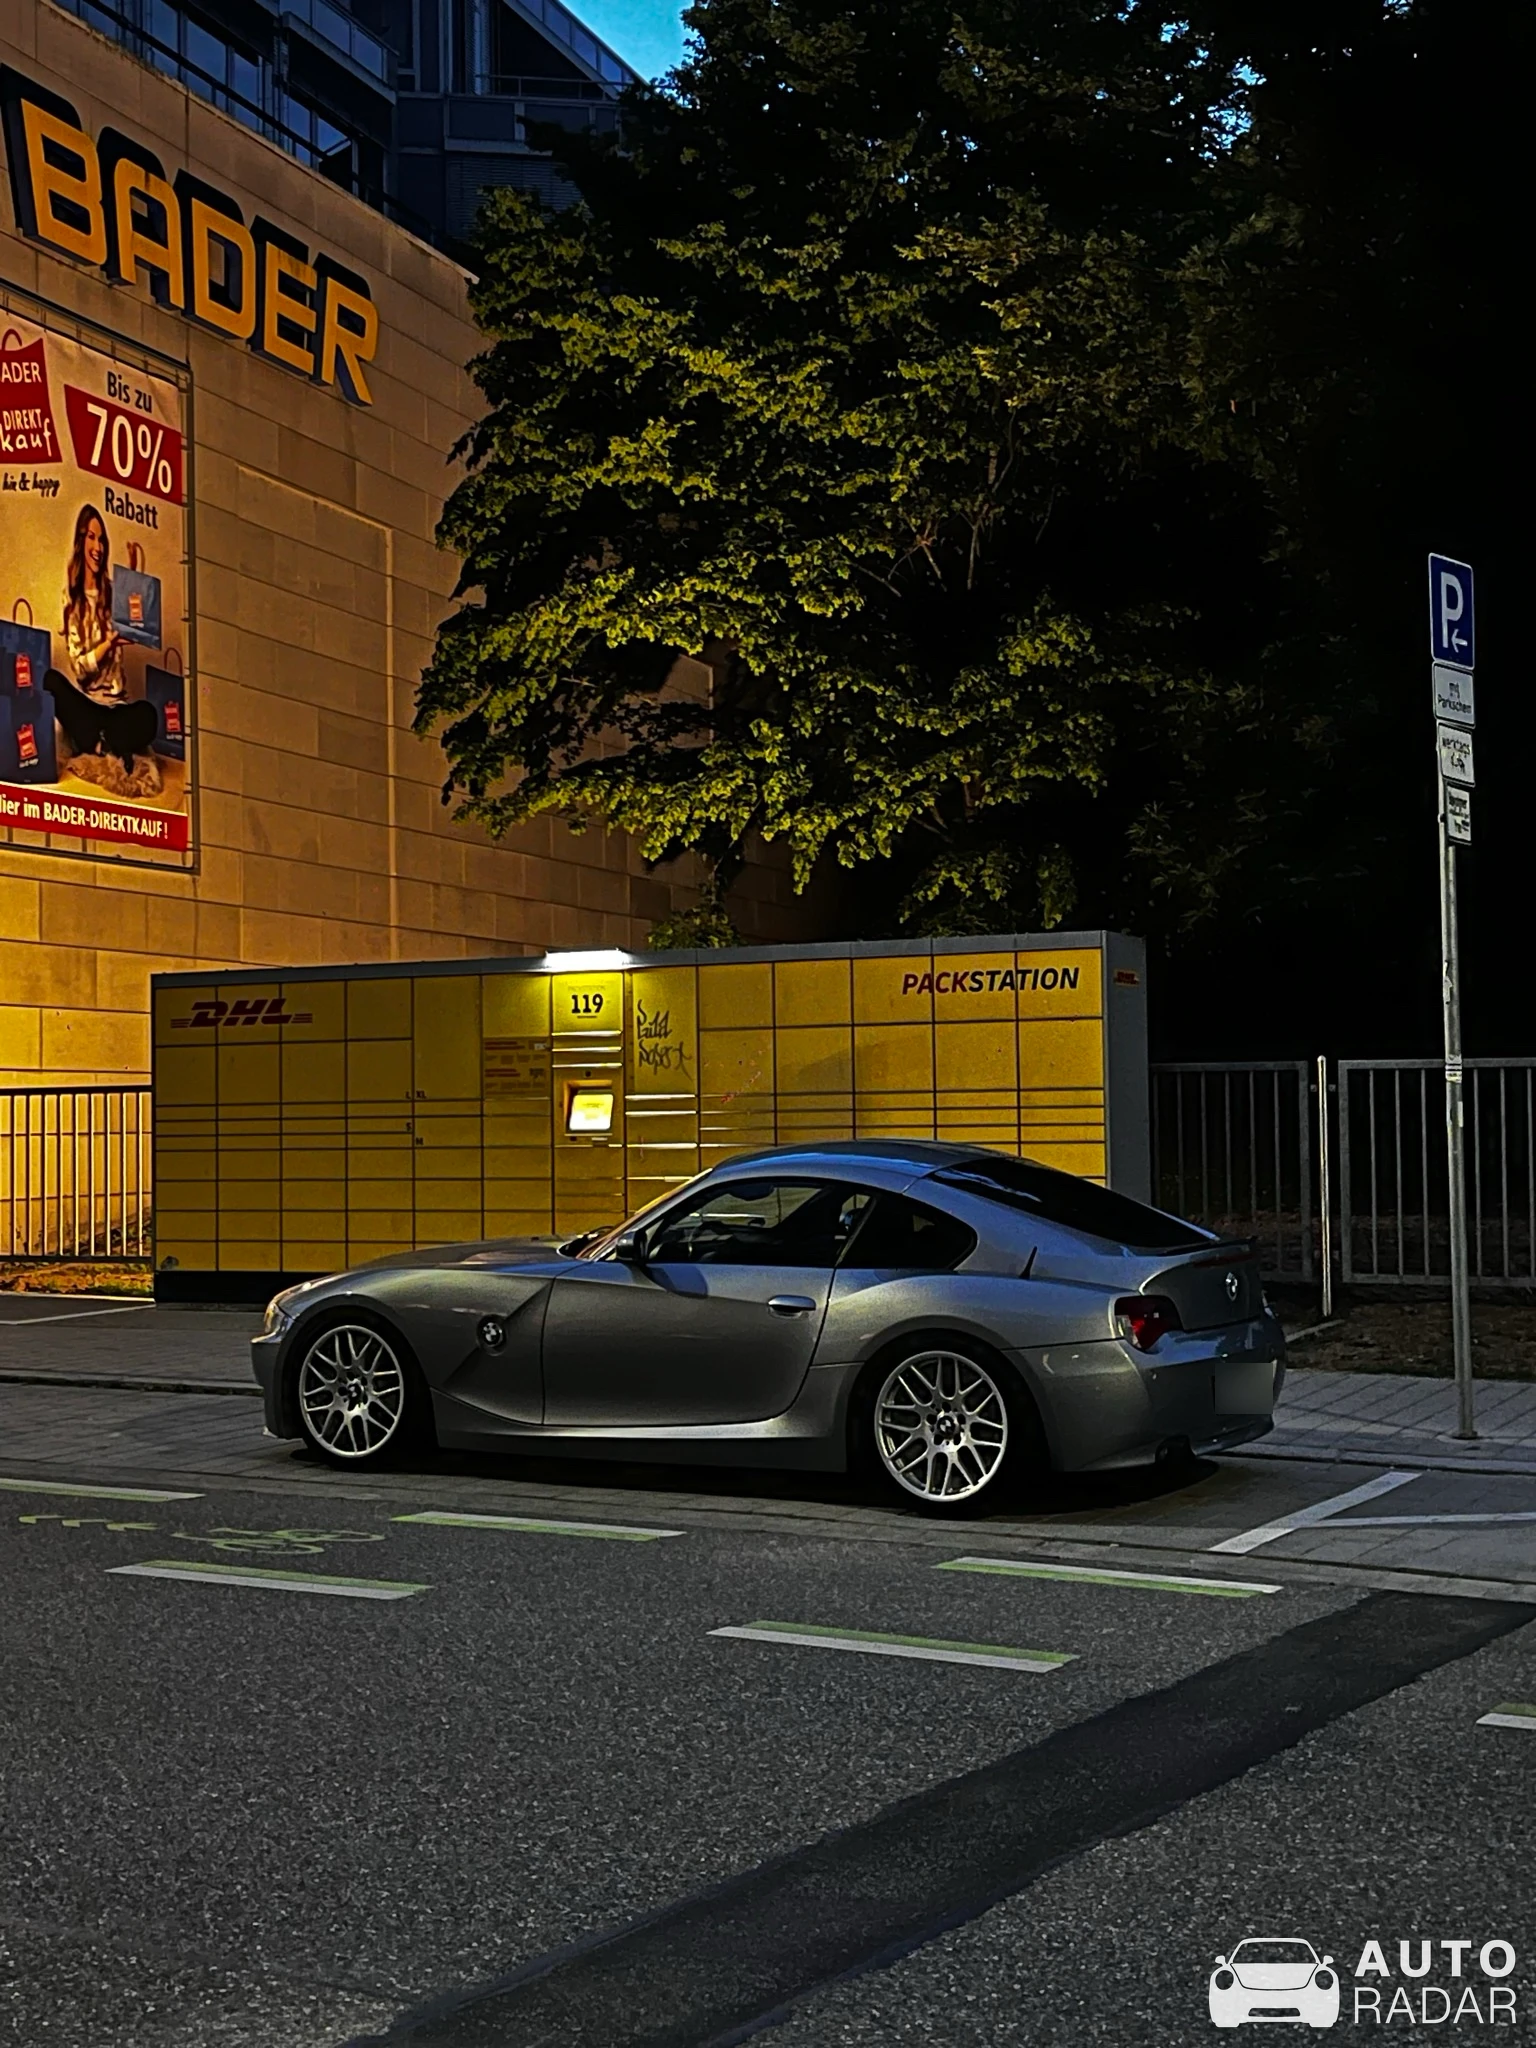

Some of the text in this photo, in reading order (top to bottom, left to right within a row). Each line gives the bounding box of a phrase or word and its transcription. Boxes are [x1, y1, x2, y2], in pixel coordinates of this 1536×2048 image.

[21, 98, 379, 406] BADER
[107, 371, 153, 414] Bis zu
[0, 418, 52, 457] kauf
[2, 408, 42, 431] DIREKT
[87, 402, 172, 494] 70%
[104, 487, 159, 529] Rabatt
[1441, 571, 1464, 649] P
[0, 793, 21, 816] ier
[24, 797, 40, 819] im
[902, 967, 1080, 995] PACKSTATION
[189, 998, 293, 1028] DHL
[571, 993, 604, 1014] 119
